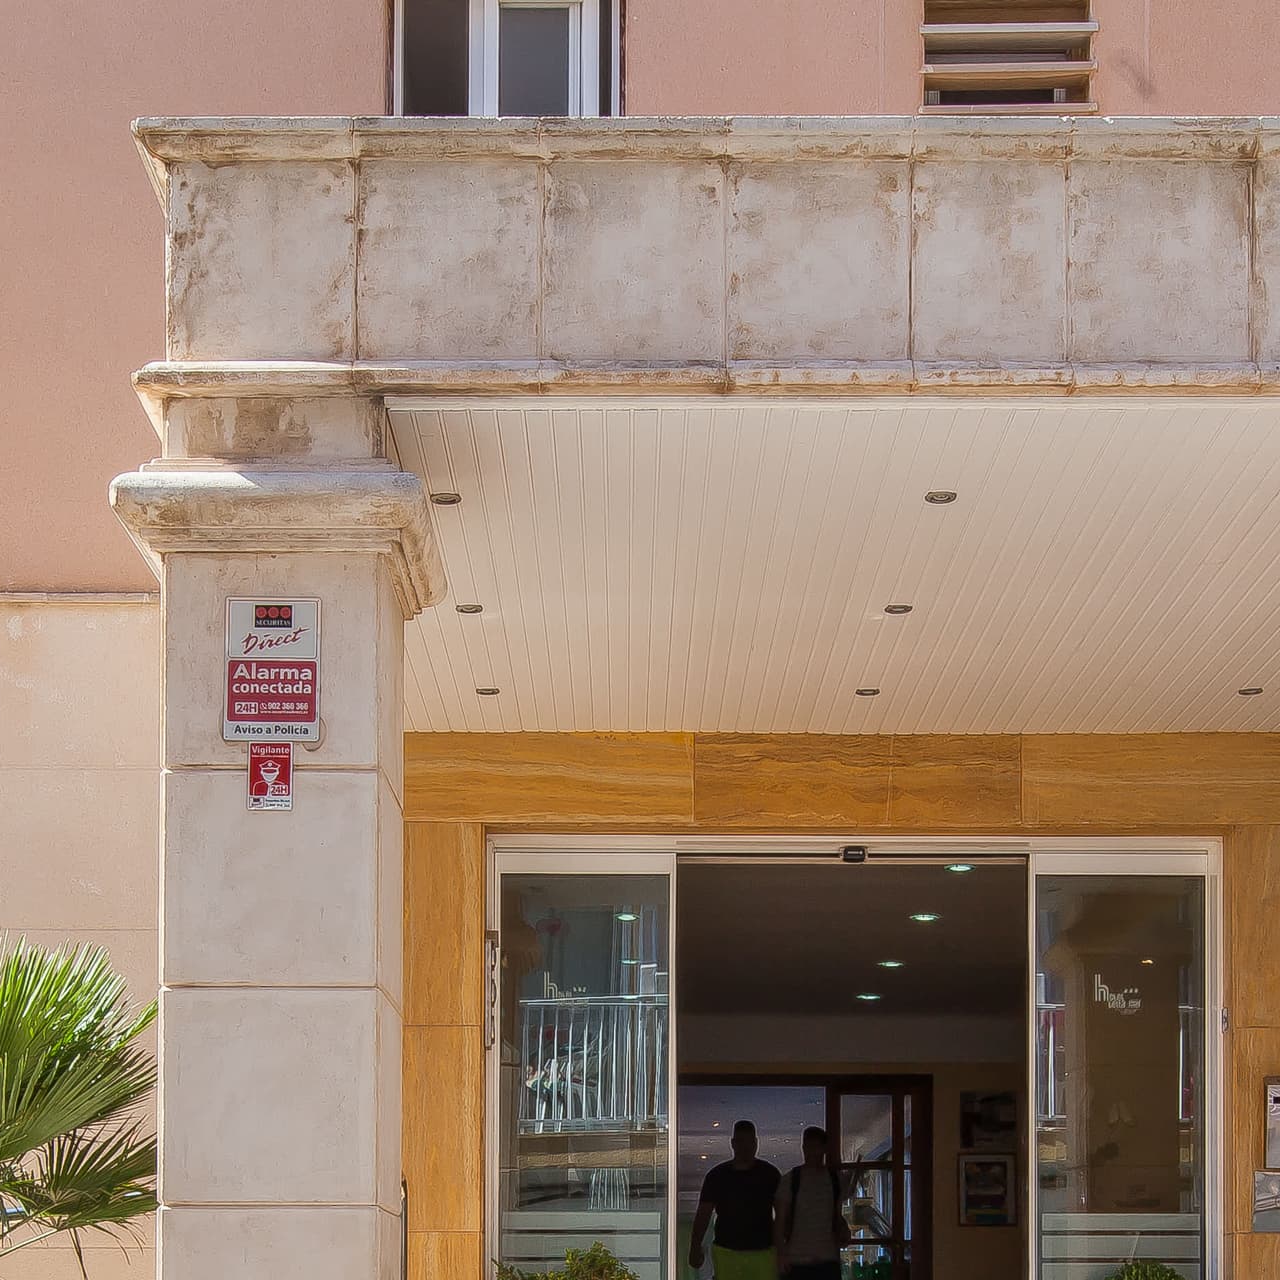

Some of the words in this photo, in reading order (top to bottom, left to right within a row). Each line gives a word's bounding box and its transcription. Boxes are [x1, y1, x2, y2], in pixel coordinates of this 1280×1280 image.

[242, 627, 310, 654] Direct
[232, 662, 312, 680] Alarma
[232, 681, 312, 694] conectada
[236, 703, 257, 713] 24H
[234, 725, 263, 734] Aviso
[274, 725, 309, 735] Policía
[251, 745, 290, 755] Vigilante
[271, 785, 287, 794] 24H
